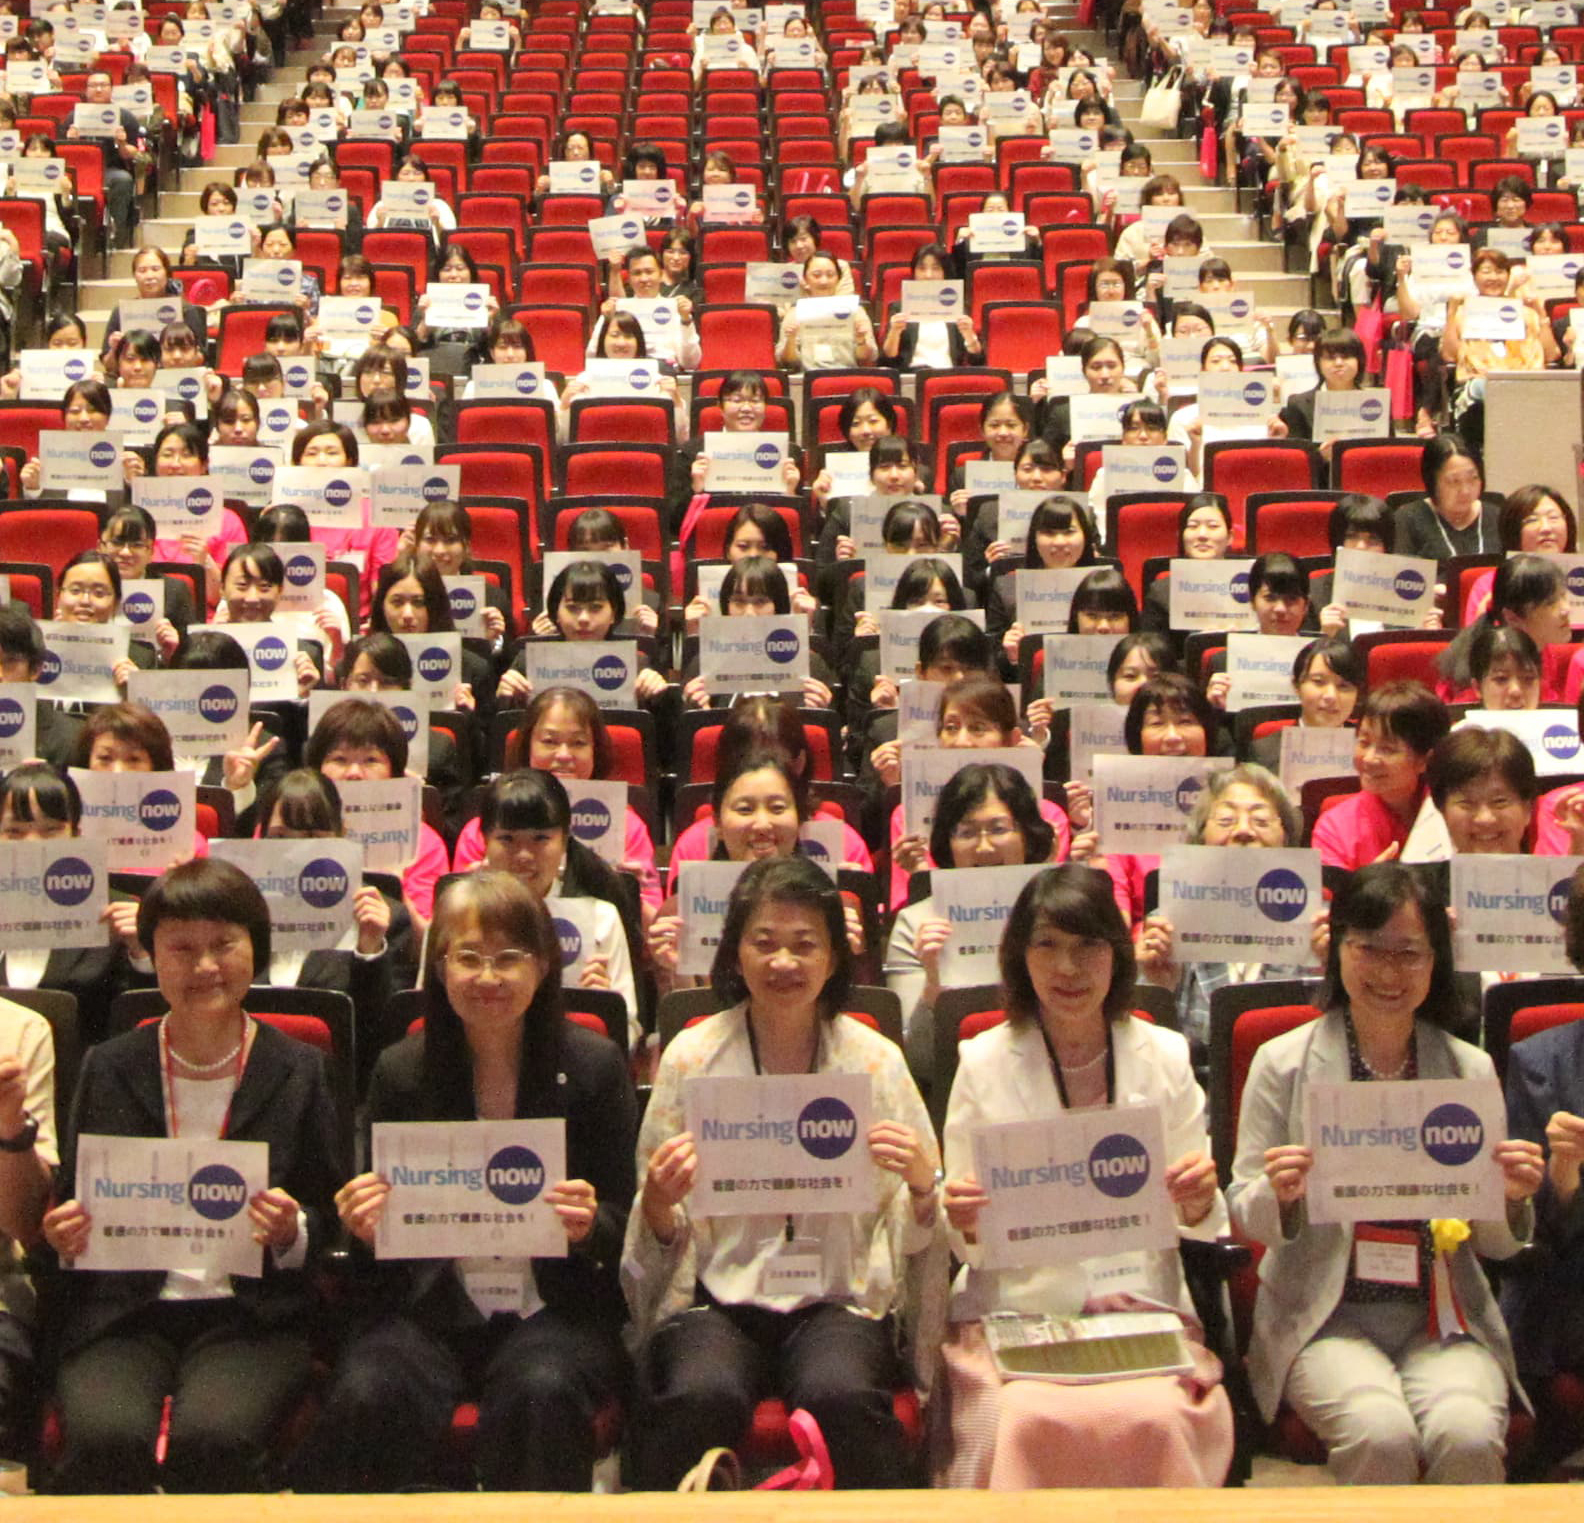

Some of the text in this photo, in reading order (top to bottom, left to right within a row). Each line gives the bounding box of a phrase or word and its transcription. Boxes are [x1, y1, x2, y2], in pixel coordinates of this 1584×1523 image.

[1244, 388, 1267, 399] now
[92, 449, 115, 461] now
[712, 449, 780, 463] Nursing now
[1110, 461, 1178, 475] Nursing now
[140, 495, 213, 509] Nursing now
[288, 563, 314, 577] now
[1178, 580, 1230, 596] Nursing
[1343, 569, 1425, 592] Nursing now
[125, 602, 152, 614] now
[708, 638, 798, 654] Nursing now
[255, 648, 287, 660] now
[419, 657, 450, 671] now
[536, 665, 627, 684] Nursing now
[138, 697, 236, 715] Nursing now
[1545, 734, 1577, 749] now
[1106, 787, 1174, 807] Nursing
[142, 803, 179, 817] now
[571, 813, 610, 827] now
[47, 876, 91, 891] now
[302, 877, 348, 892] now
[1173, 880, 1305, 906] Nursing now
[1467, 889, 1545, 915] Nursing
[702, 1116, 855, 1147] Nursing now
[1321, 1122, 1481, 1154] Nursing now
[392, 1165, 544, 1191] Nursing now
[991, 1155, 1147, 1189] Nursing now
[94, 1178, 247, 1205] Nursing now
[712, 1177, 854, 1192] 看護の力で健康な社会を！
[1333, 1182, 1481, 1198] 看護の力で健康な社会を！
[1007, 1214, 1152, 1241] 看護の力で健康な社会を！
